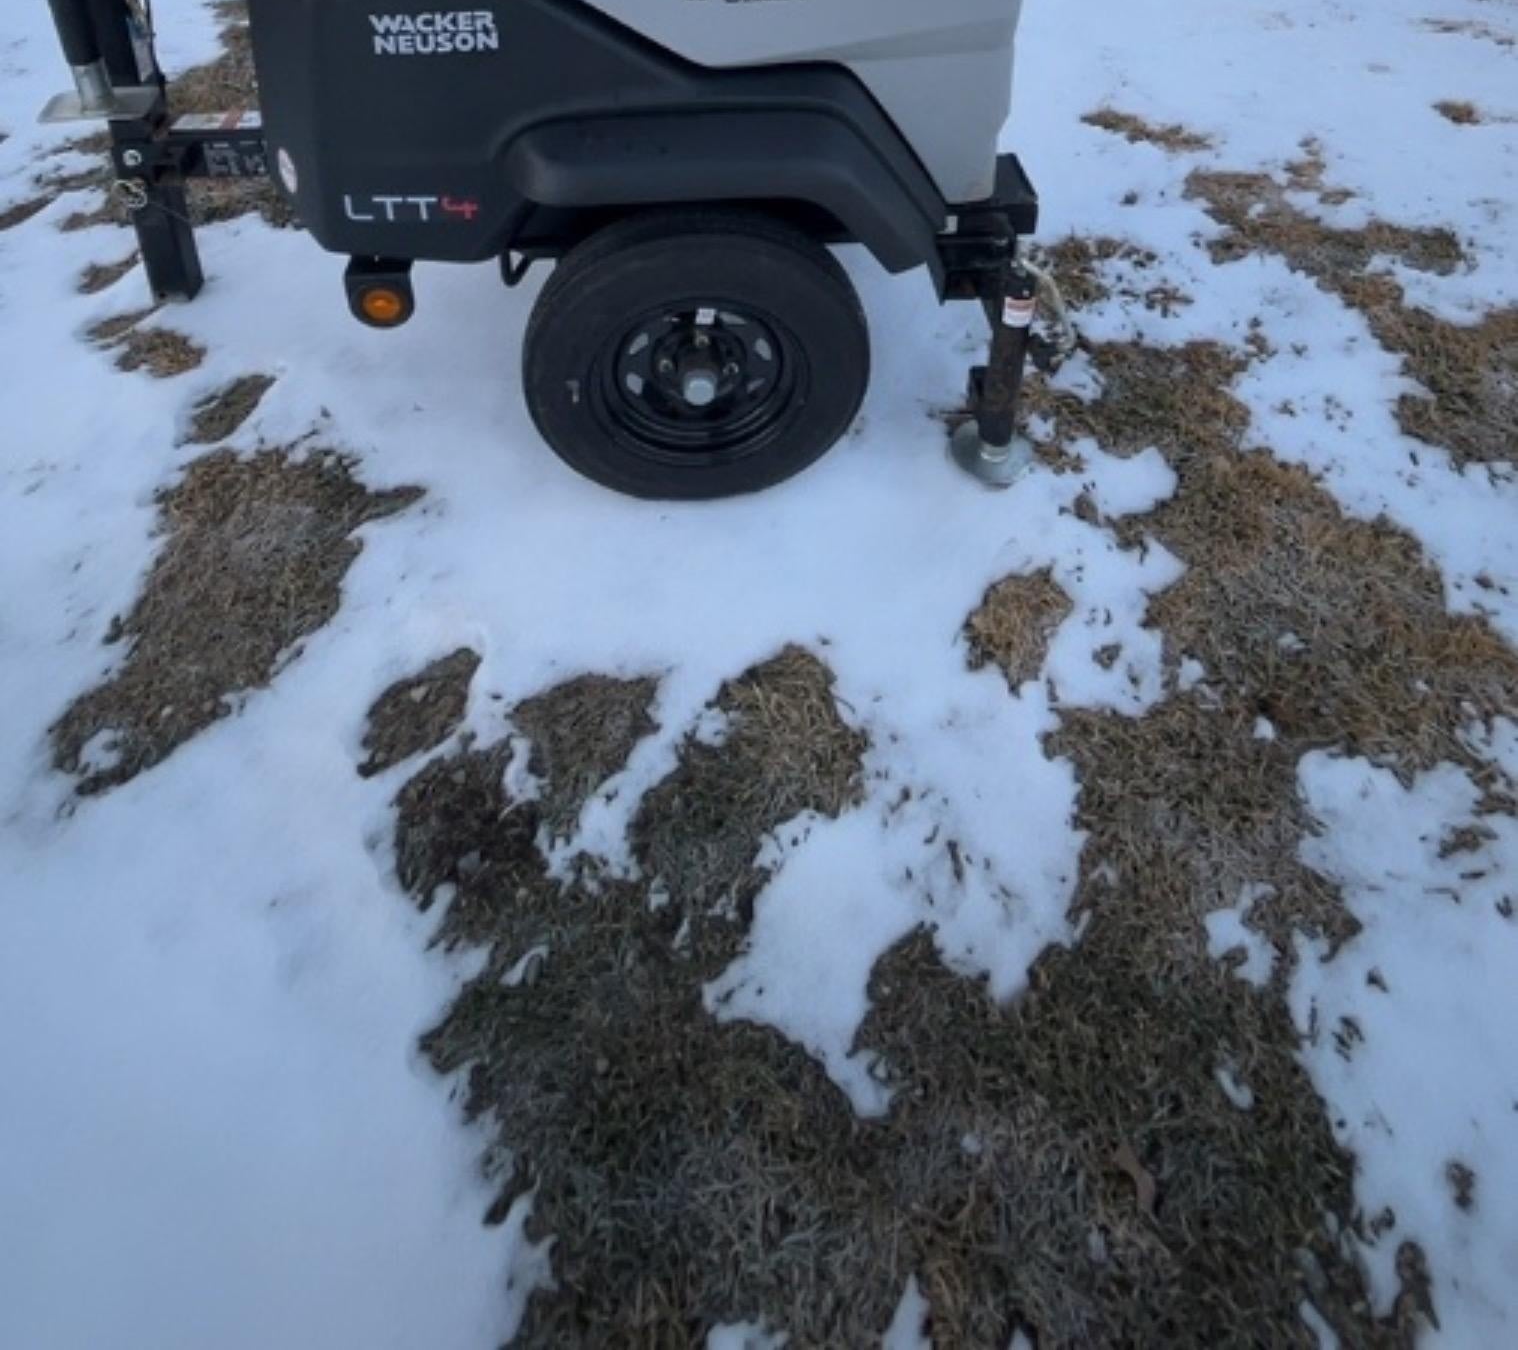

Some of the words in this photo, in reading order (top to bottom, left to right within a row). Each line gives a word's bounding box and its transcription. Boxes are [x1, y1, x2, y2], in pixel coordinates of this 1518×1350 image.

[369, 11, 496, 34] WACKER
[373, 31, 499, 55] NEUSON
[344, 195, 479, 220] LTT4
